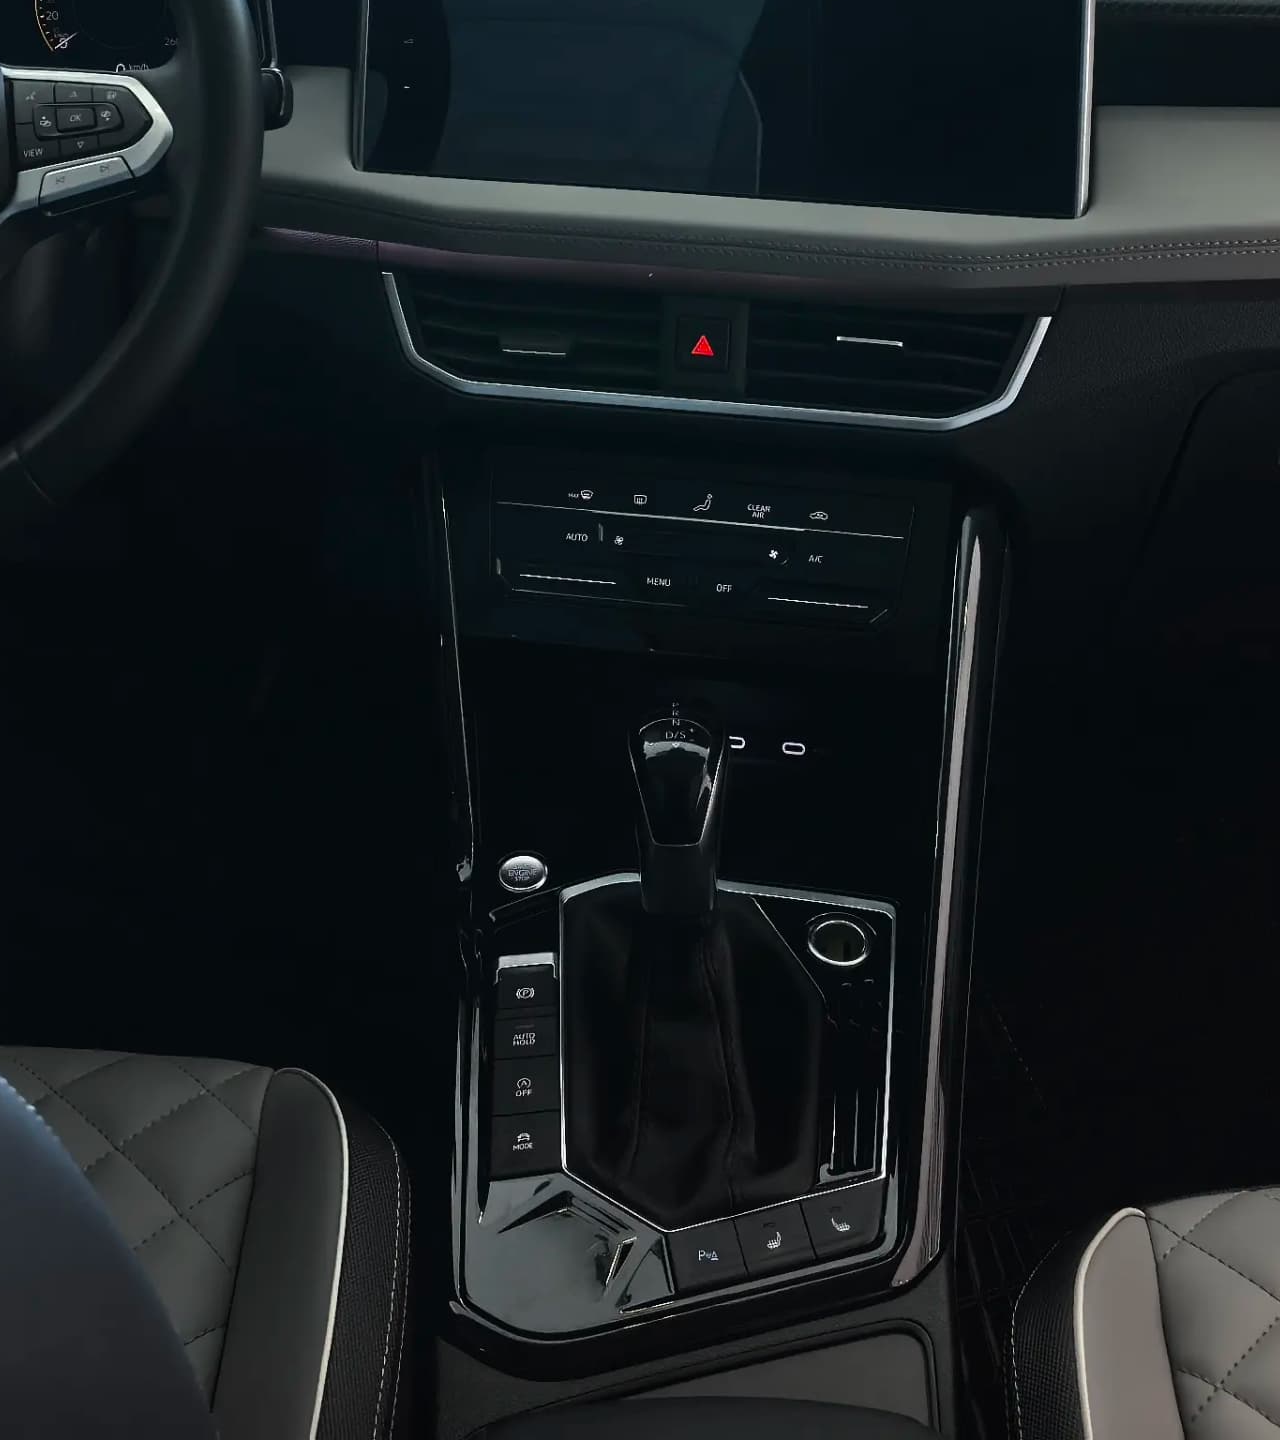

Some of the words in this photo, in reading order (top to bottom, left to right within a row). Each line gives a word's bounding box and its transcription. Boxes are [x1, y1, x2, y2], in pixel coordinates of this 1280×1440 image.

[46, 10, 59, 21] 20
[69, 113, 82, 123] OK
[22, 148, 44, 158] VIEW
[747, 503, 771, 513] CLEAR
[751, 511, 765, 520] AIR
[566, 532, 589, 543] AUTO
[808, 554, 824, 564] A/C
[646, 576, 671, 587] MENU
[716, 583, 733, 593] OFF
[665, 730, 687, 740] D/S
[512, 1032, 536, 1041] AUTO
[512, 1038, 536, 1047] HOLD
[515, 1088, 533, 1097] OFF
[512, 1142, 534, 1152] MODE
